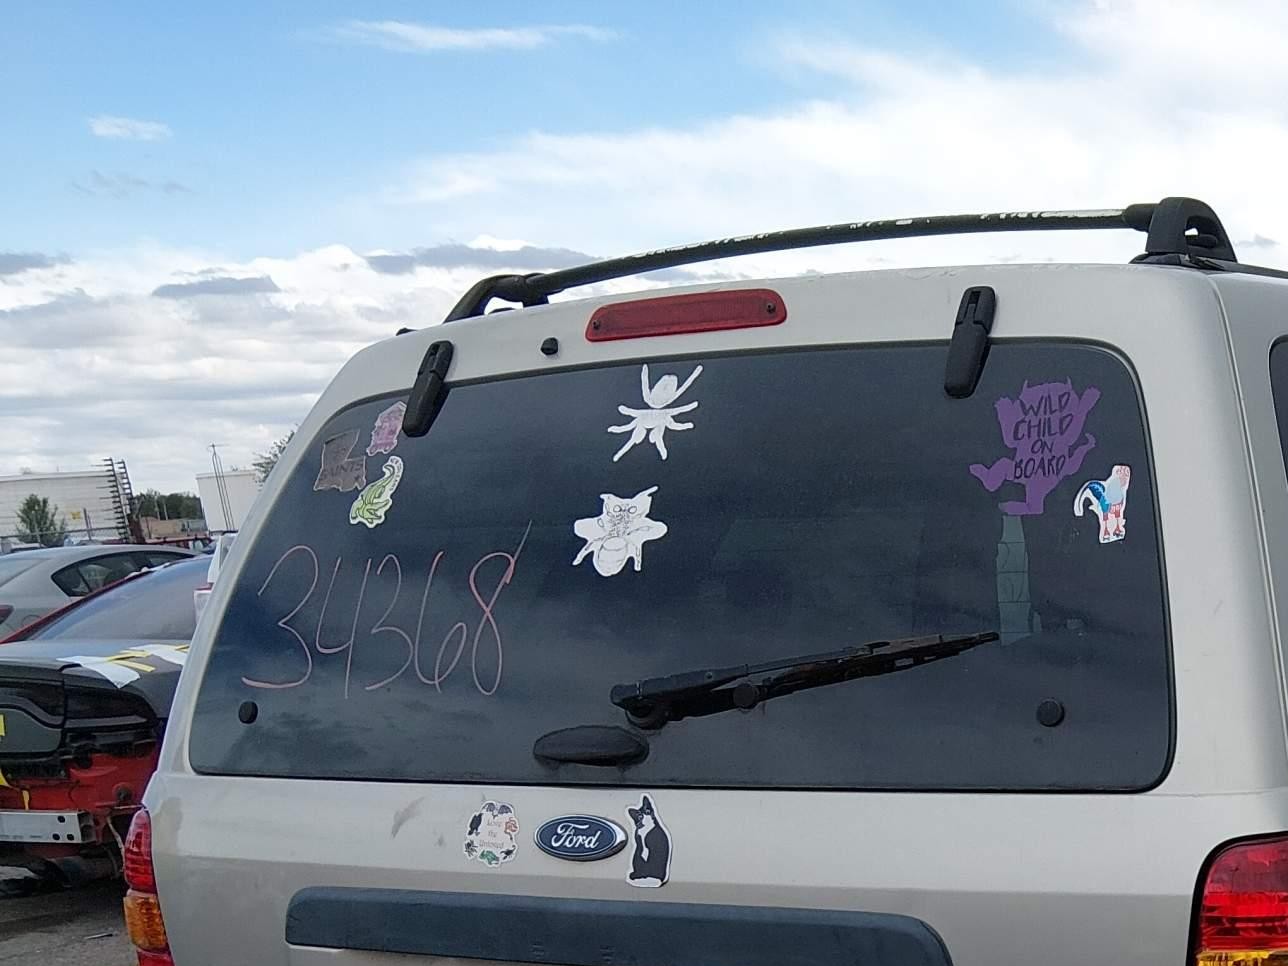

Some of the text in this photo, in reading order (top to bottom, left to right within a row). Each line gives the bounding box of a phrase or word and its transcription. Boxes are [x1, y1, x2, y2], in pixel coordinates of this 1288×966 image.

[1020, 391, 1071, 416] WILD
[1013, 413, 1074, 440] CHILD
[1031, 439, 1054, 454] ON
[1014, 454, 1066, 479] BOARD
[241, 519, 532, 699] 34368
[551, 822, 601, 849] Ford
